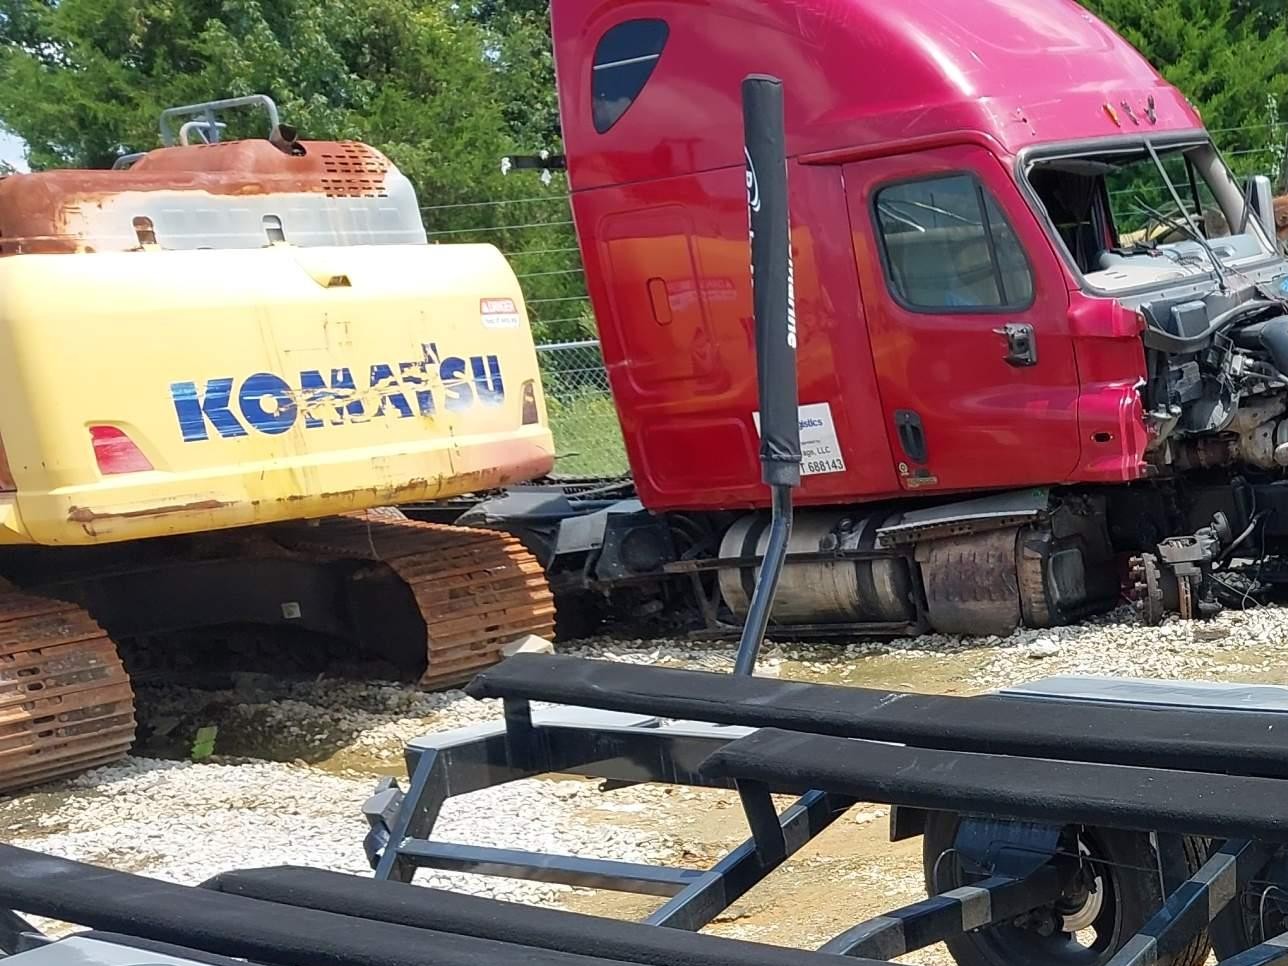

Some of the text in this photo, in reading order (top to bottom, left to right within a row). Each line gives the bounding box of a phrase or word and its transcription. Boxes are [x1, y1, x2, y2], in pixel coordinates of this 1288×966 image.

[170, 343, 505, 443] KOMATSU
[800, 418, 823, 430] gistics
[816, 446, 831, 455] LLC
[808, 459, 844, 473] 688143
